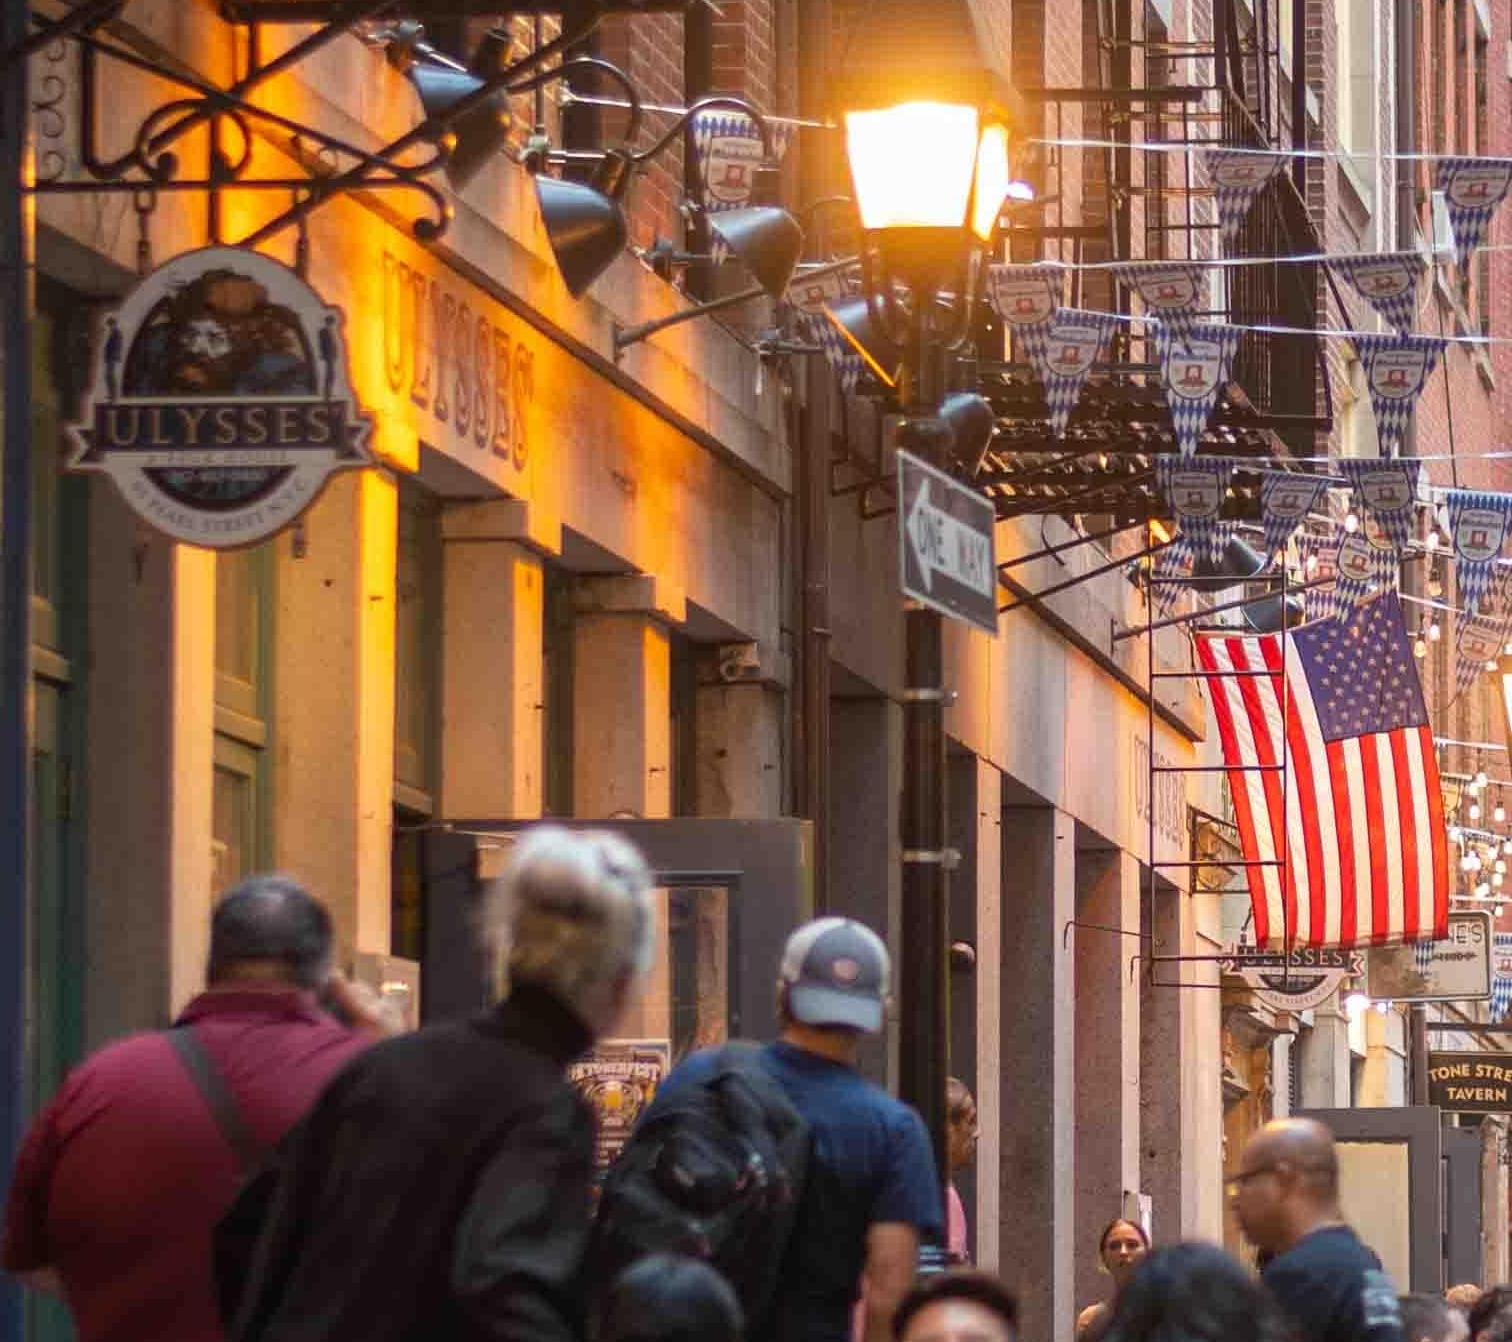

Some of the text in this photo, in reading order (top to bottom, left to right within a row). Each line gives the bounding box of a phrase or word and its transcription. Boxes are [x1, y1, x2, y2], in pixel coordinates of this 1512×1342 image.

[917, 507, 946, 566] ONE
[1429, 1064, 1470, 1080] TONE
[1447, 1087, 1507, 1102] TAVERN
